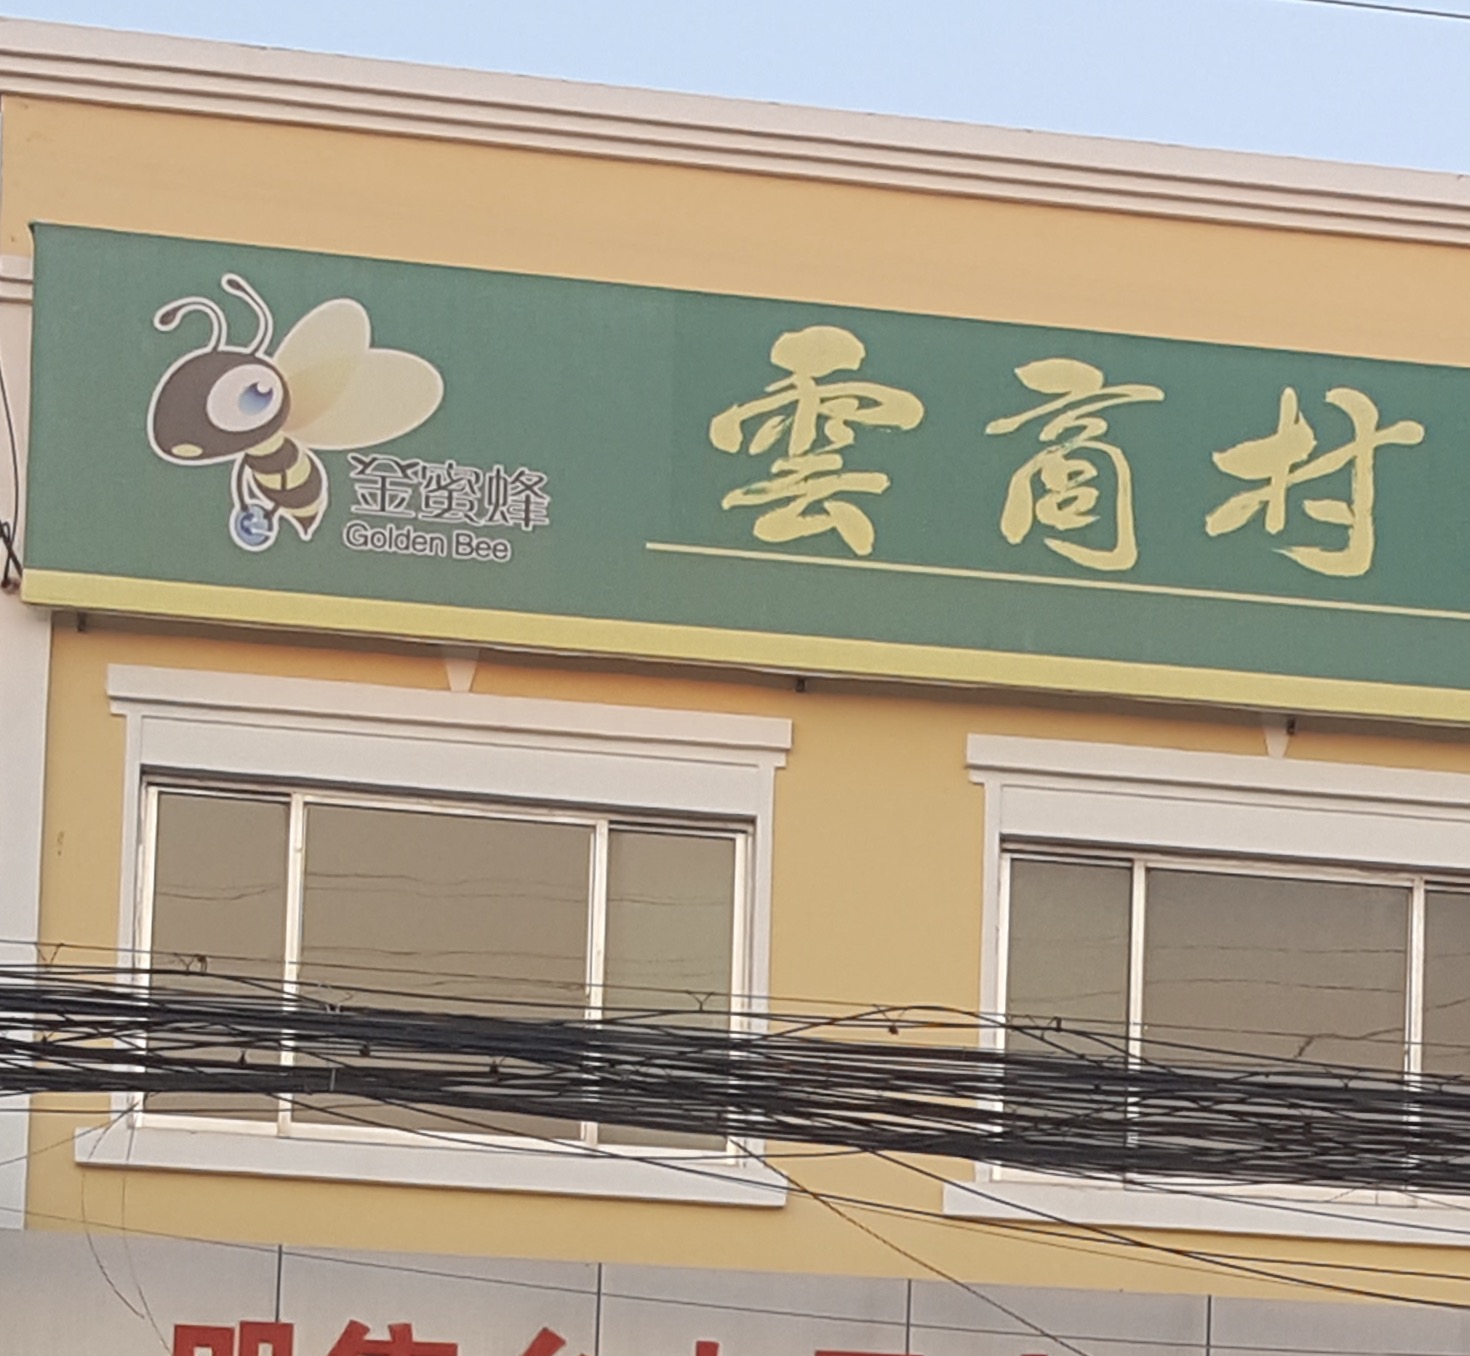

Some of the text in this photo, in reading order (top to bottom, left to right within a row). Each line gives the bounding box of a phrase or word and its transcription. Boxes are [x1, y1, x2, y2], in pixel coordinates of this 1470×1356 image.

[348, 453, 551, 532] 金蜜蜂
[344, 521, 512, 562] Golden Bee
